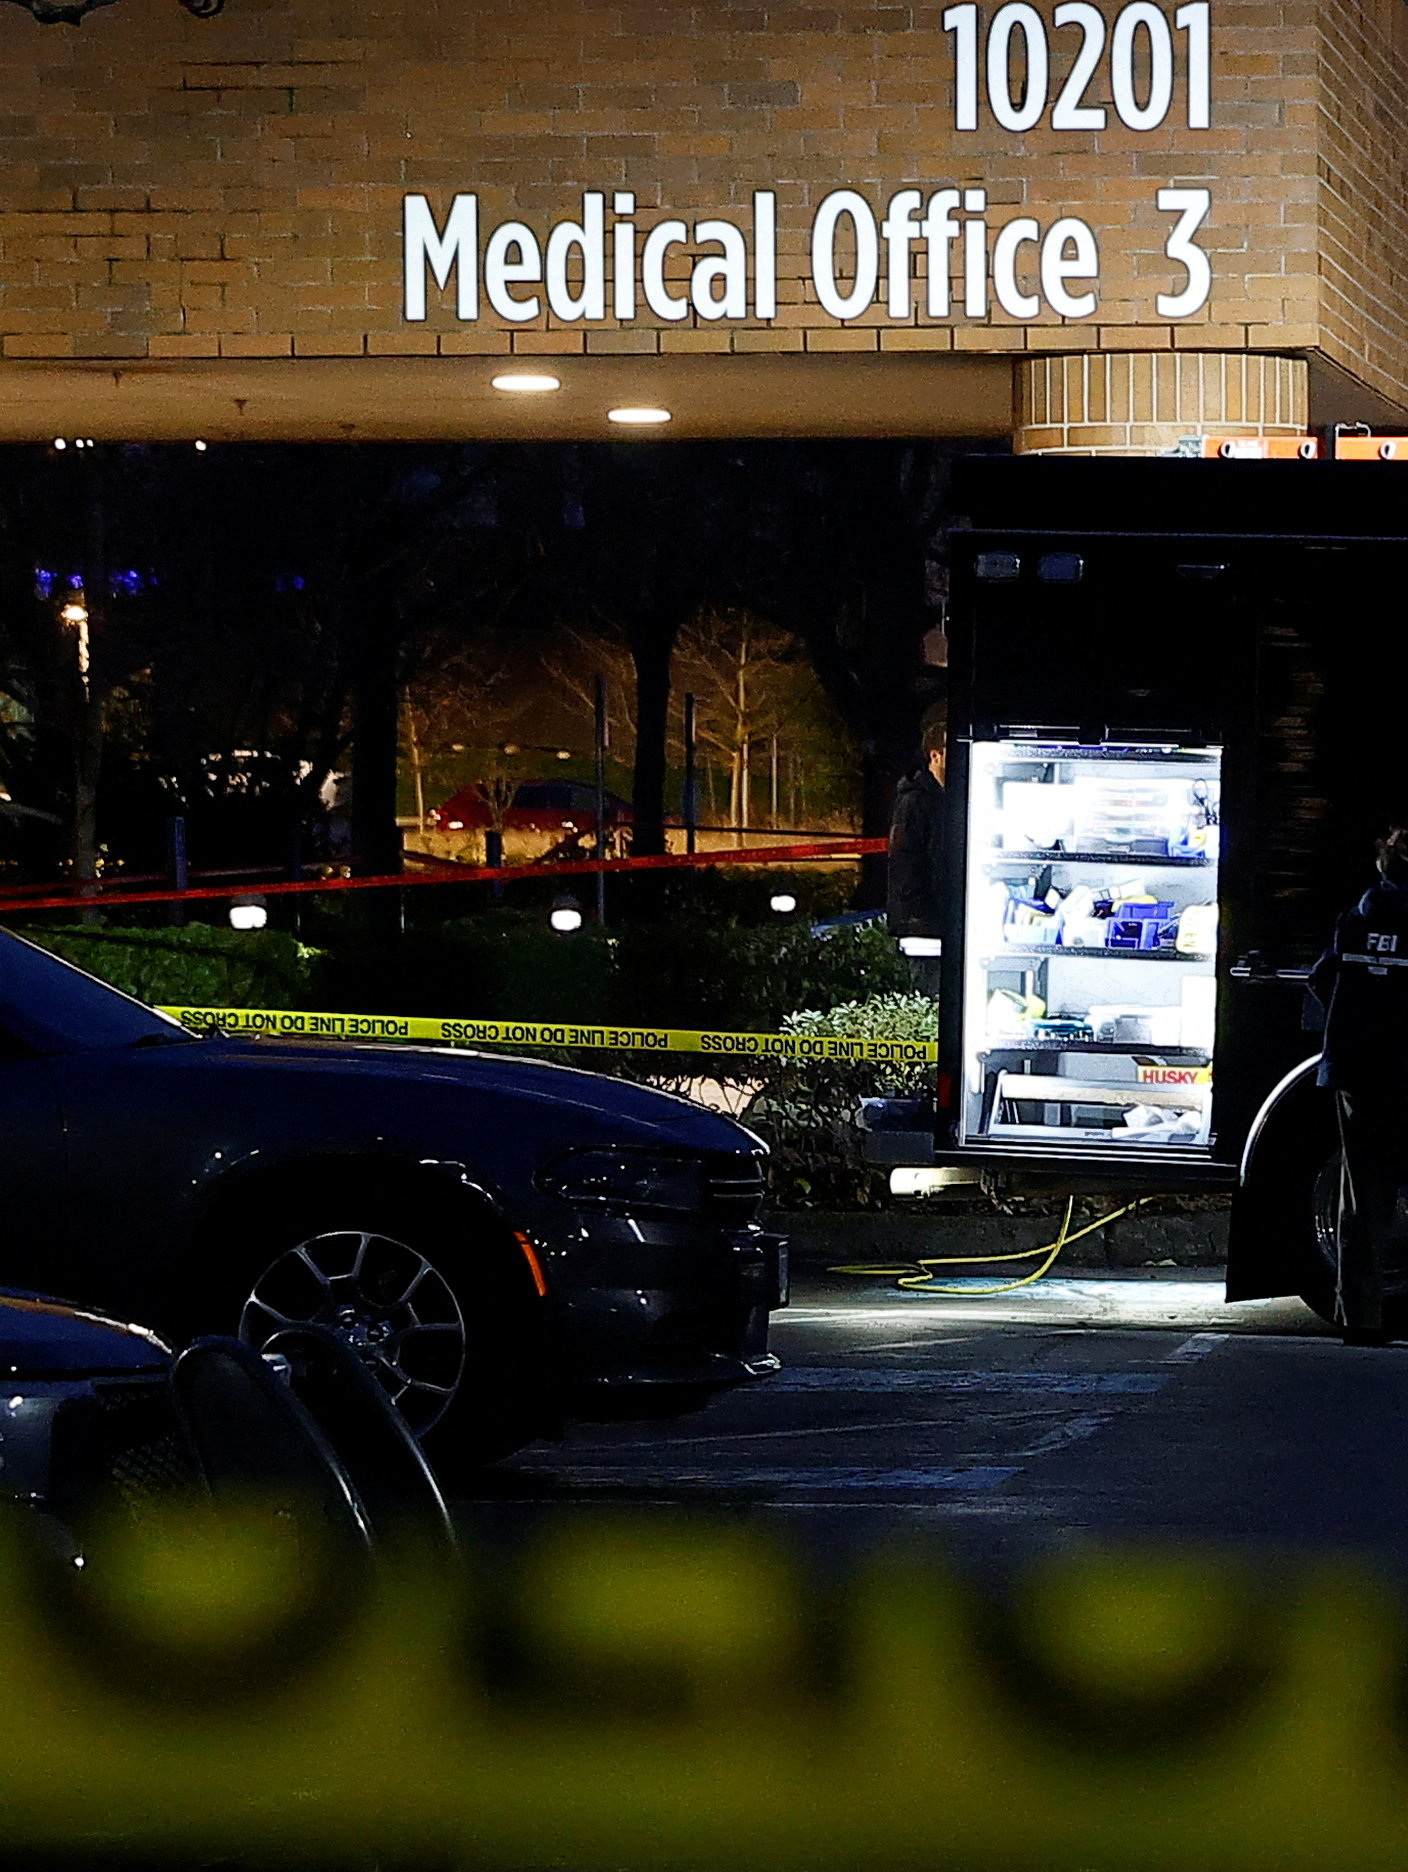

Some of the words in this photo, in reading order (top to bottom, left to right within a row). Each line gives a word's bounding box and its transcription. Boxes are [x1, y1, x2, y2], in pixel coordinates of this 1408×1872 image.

[944, 2, 1211, 131] 10201
[404, 191, 777, 321] Medical
[811, 189, 1098, 320] Office
[1156, 189, 1212, 319] 3
[1367, 932, 1398, 952] FBI
[180, 1009, 240, 1030] CROSS
[243, 1012, 277, 1031] NOT
[280, 1014, 306, 1032] DO
[309, 1015, 346, 1034] LINE
[349, 1017, 409, 1037] POLICE
[440, 1022, 500, 1041] CROSS
[502, 1025, 538, 1043] NOT
[540, 1026, 566, 1044] DO
[568, 1028, 606, 1046] LINE
[608, 1030, 669, 1048] POLICE
[700, 1033, 760, 1052] CROSS
[762, 1036, 797, 1055] NOT
[799, 1038, 825, 1056] DO
[827, 1040, 865, 1058] LINE
[866, 1042, 928, 1060] POLICE
[1143, 1069, 1199, 1084] HUSKY
